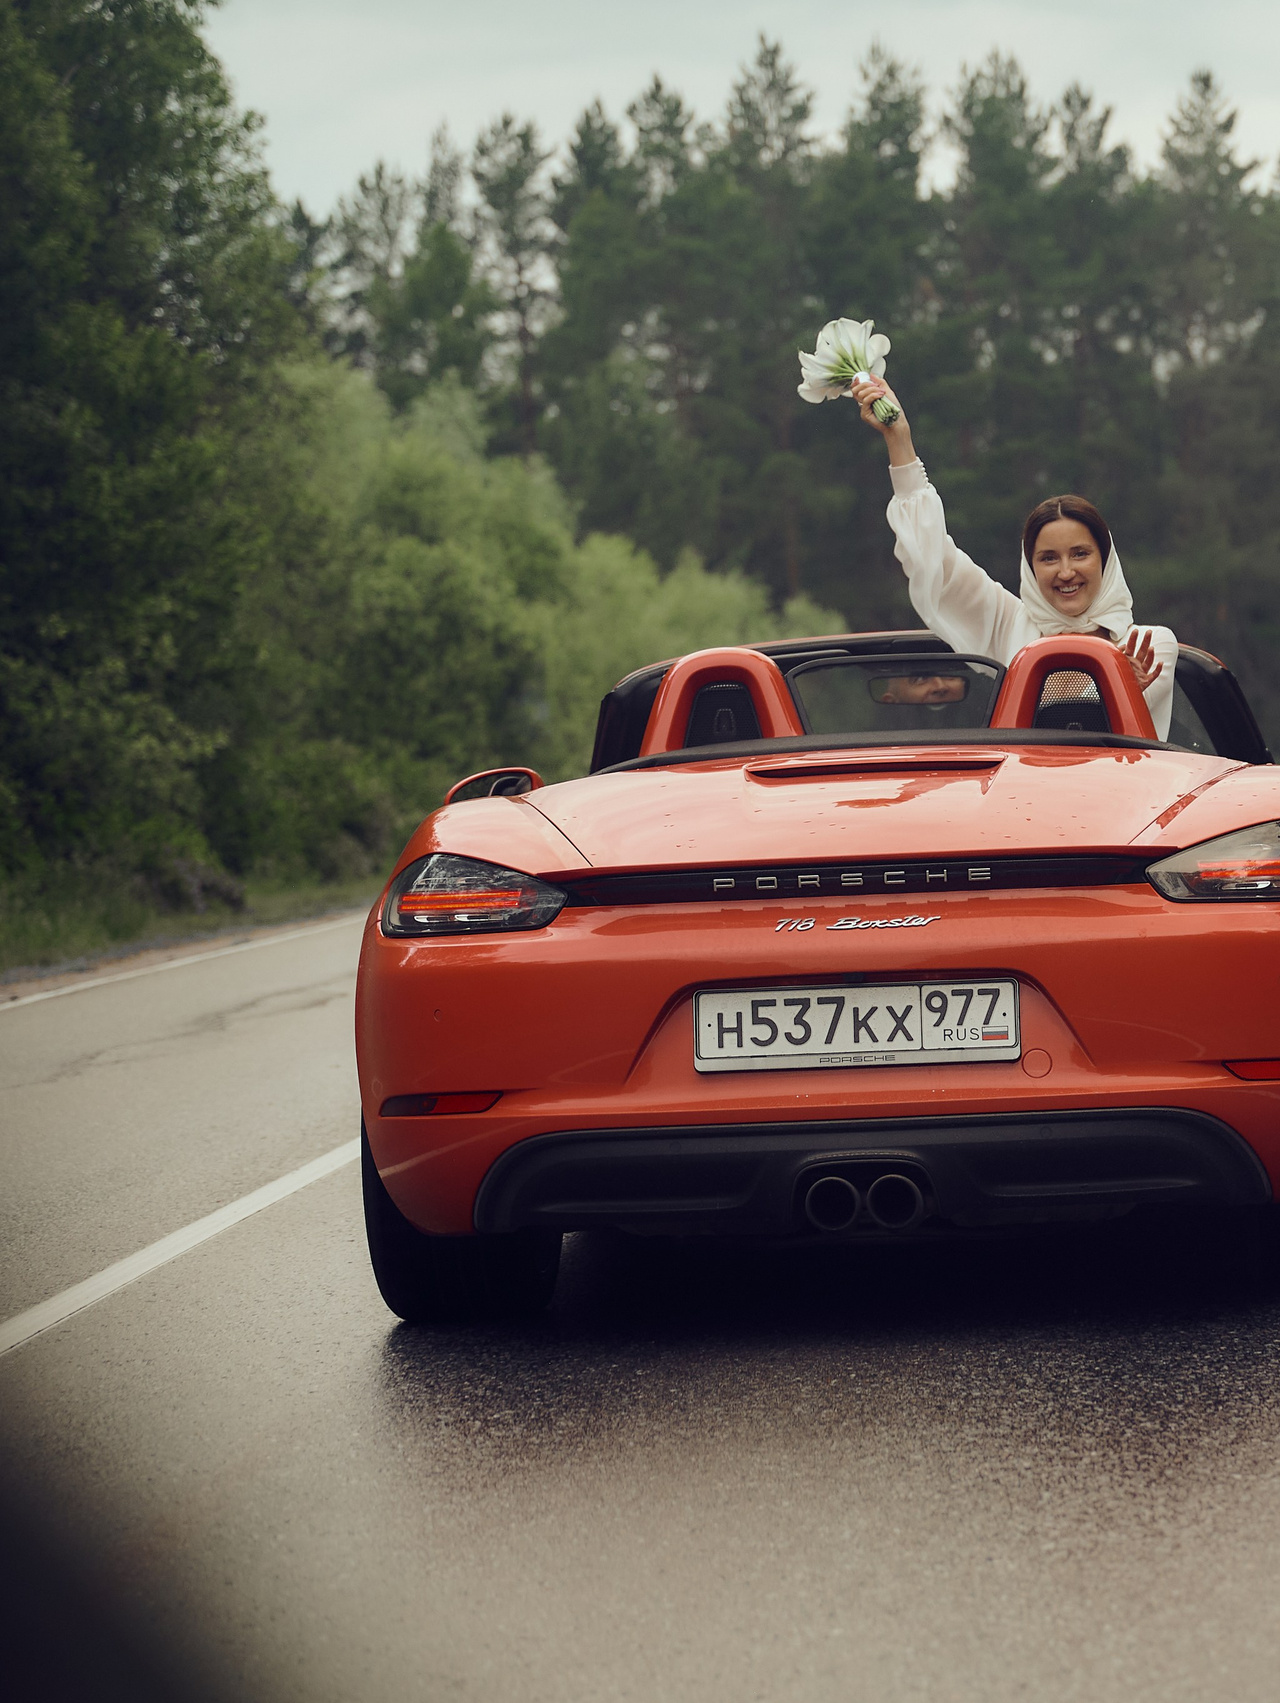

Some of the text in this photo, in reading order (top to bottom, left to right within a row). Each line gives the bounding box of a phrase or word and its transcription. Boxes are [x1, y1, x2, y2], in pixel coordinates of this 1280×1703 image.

[713, 867, 991, 892] PORSCHE
[775, 915, 941, 932] 718 Boxster
[925, 988, 1000, 1027] 977
[943, 1028, 980, 1041] RUS
[820, 1054, 896, 1063] PORSCHE
